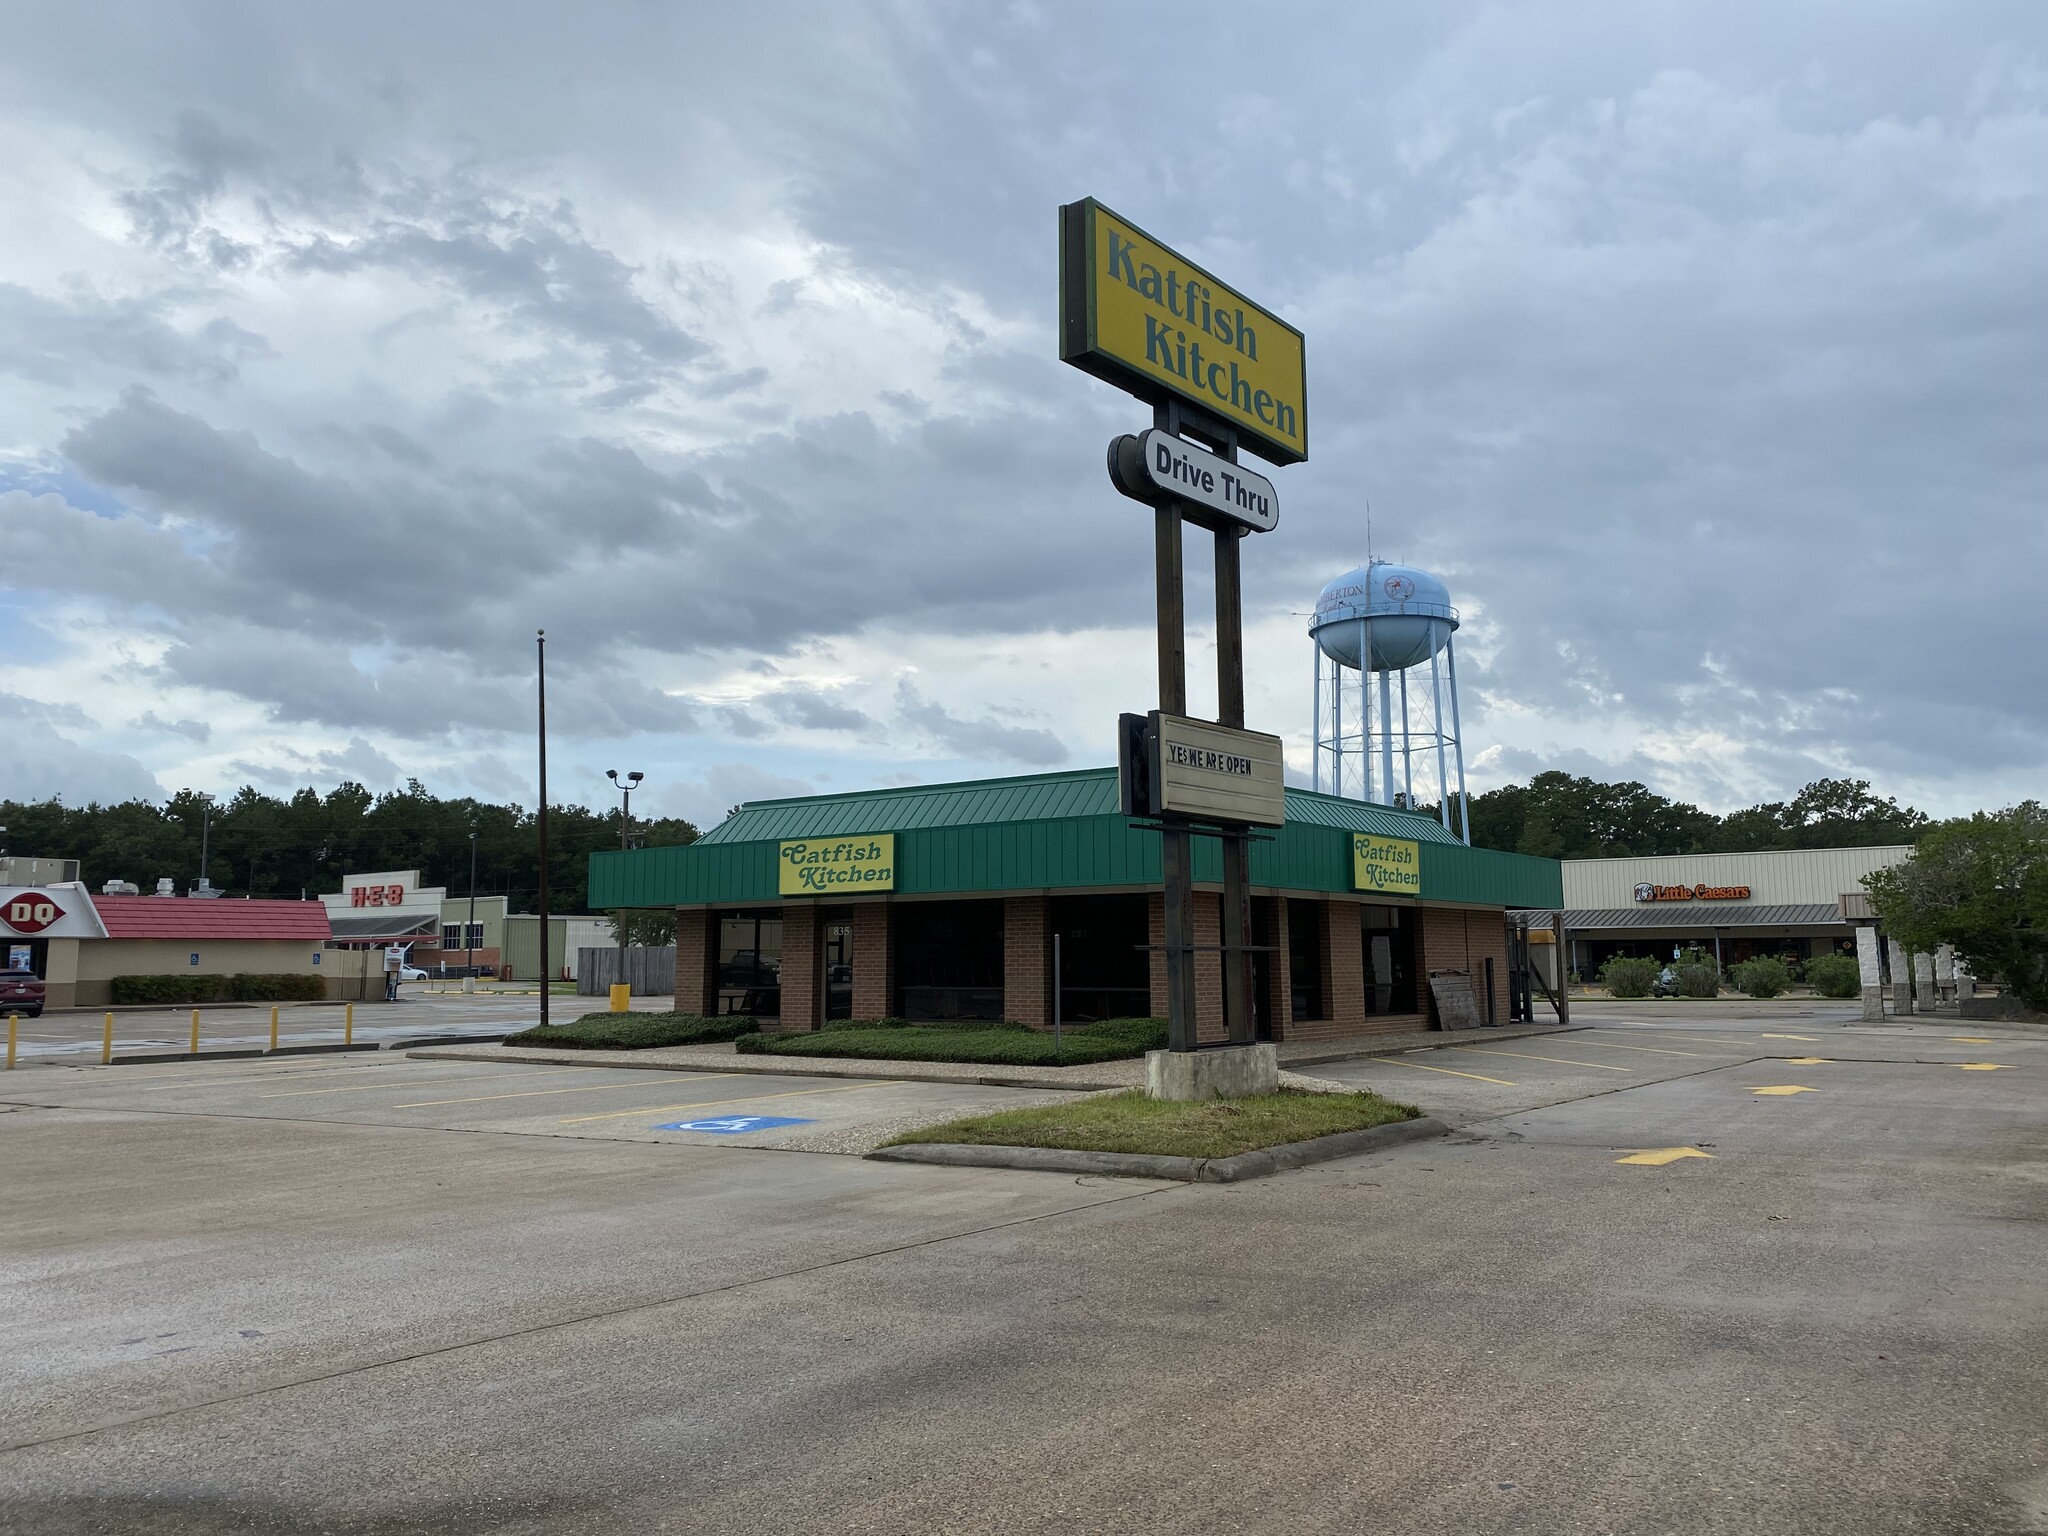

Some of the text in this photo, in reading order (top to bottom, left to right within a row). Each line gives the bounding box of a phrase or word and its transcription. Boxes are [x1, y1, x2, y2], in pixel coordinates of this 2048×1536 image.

[1107, 228, 1258, 362] Katfish
[1144, 313, 1297, 439] Kitchen
[1156, 443, 1269, 517] Drive Thru
[1189, 749, 1203, 767] WE
[1206, 752, 1224, 770] ARE
[1226, 756, 1252, 775] OPEN
[781, 842, 881, 865] Catfish
[1355, 838, 1412, 864] Catfish
[798, 864, 892, 890] Kitchen
[1366, 863, 1419, 888] Kitchen
[1655, 884, 1750, 900] Little Caesars
[10, 903, 55, 926] DQ
[833, 926, 850, 936] 835
